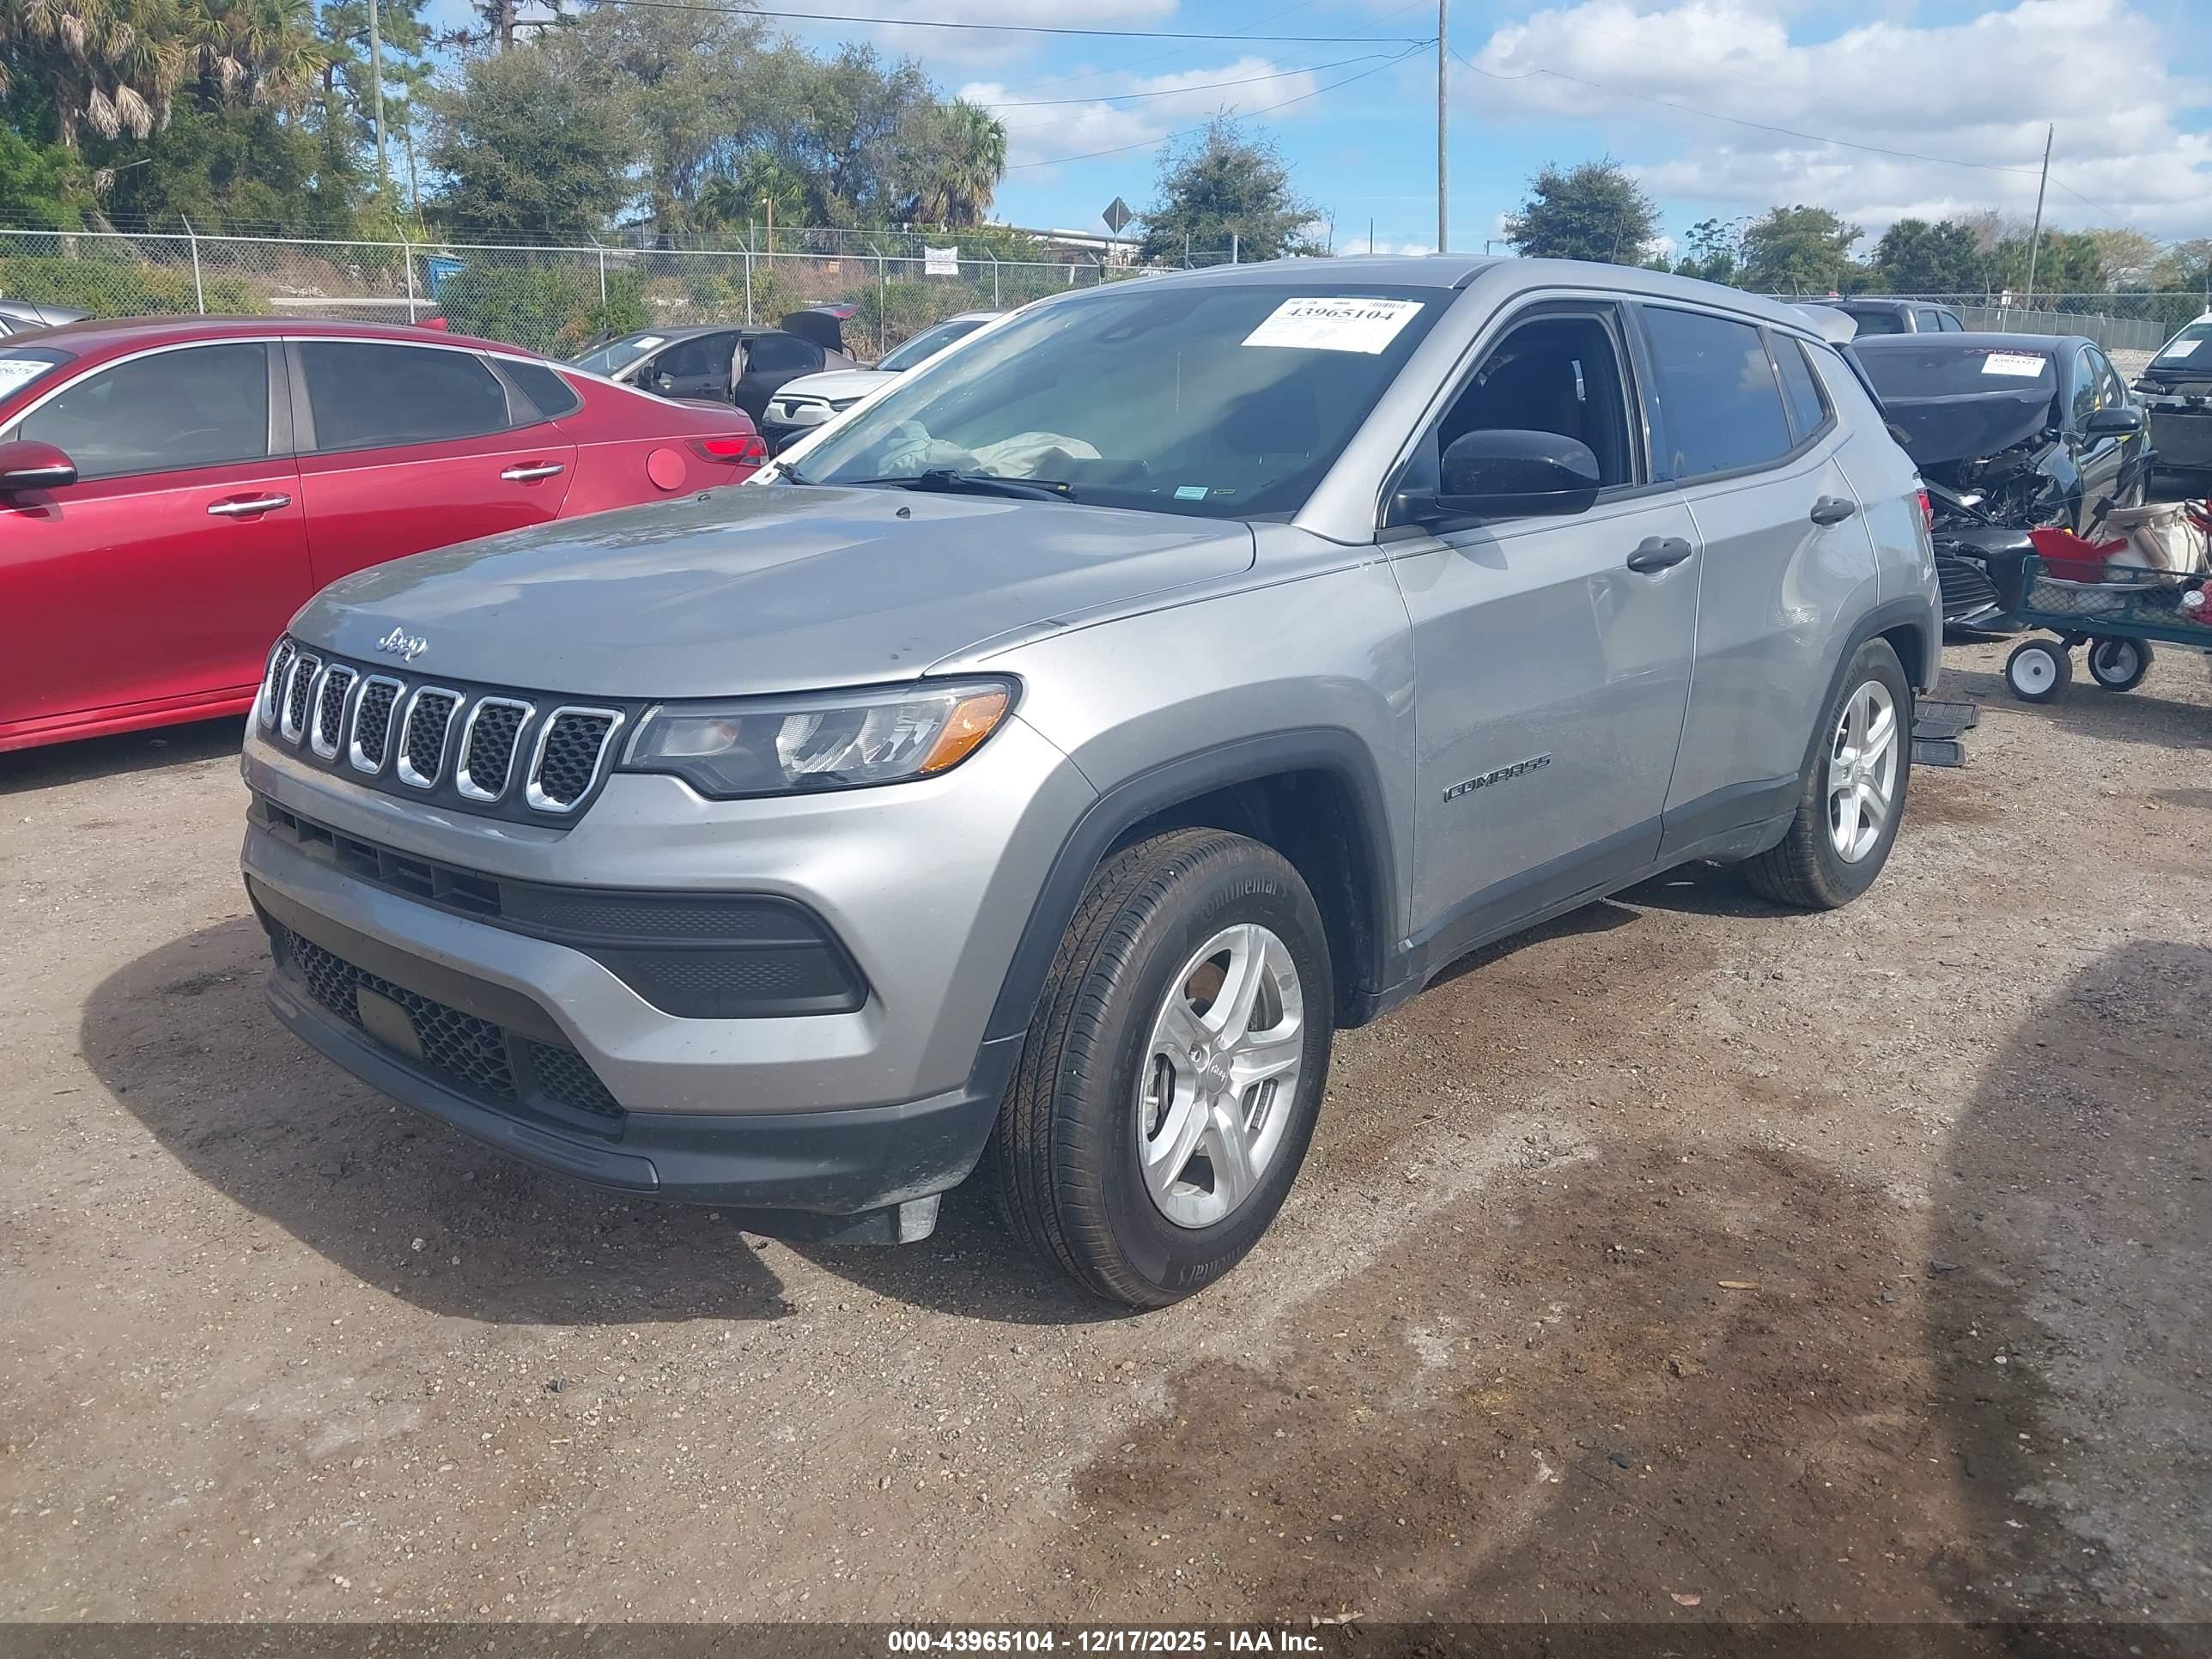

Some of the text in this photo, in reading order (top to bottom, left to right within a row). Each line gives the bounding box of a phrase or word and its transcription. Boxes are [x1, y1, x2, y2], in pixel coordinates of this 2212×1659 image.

[1286, 307, 1395, 321] 43965104
[376, 625, 428, 664] Jeep
[1443, 751, 1552, 804] COMPASS
